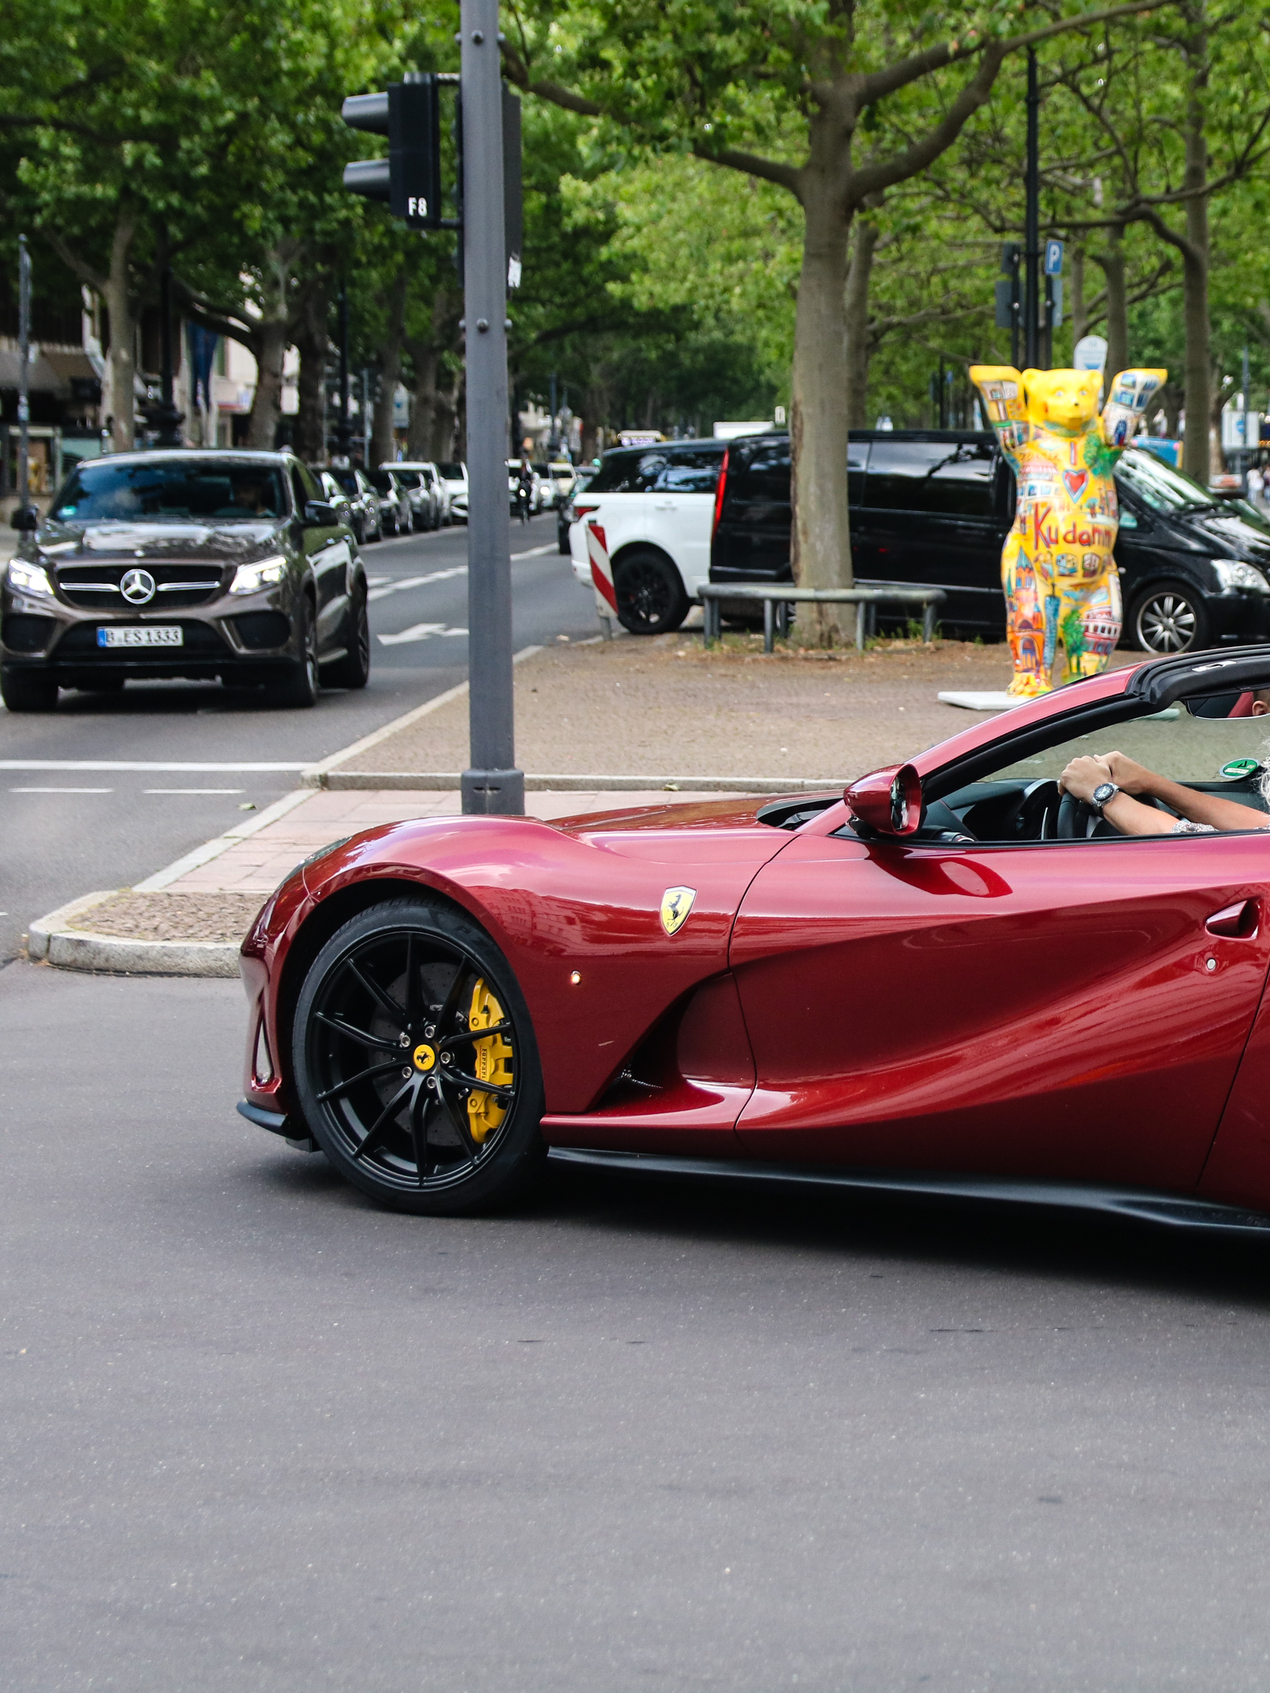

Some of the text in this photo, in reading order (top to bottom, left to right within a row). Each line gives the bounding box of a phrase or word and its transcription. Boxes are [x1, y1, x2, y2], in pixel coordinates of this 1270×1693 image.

[408, 196, 428, 217] F8
[1049, 244, 1060, 270] P
[105, 628, 115, 644] B
[123, 628, 142, 644] ES
